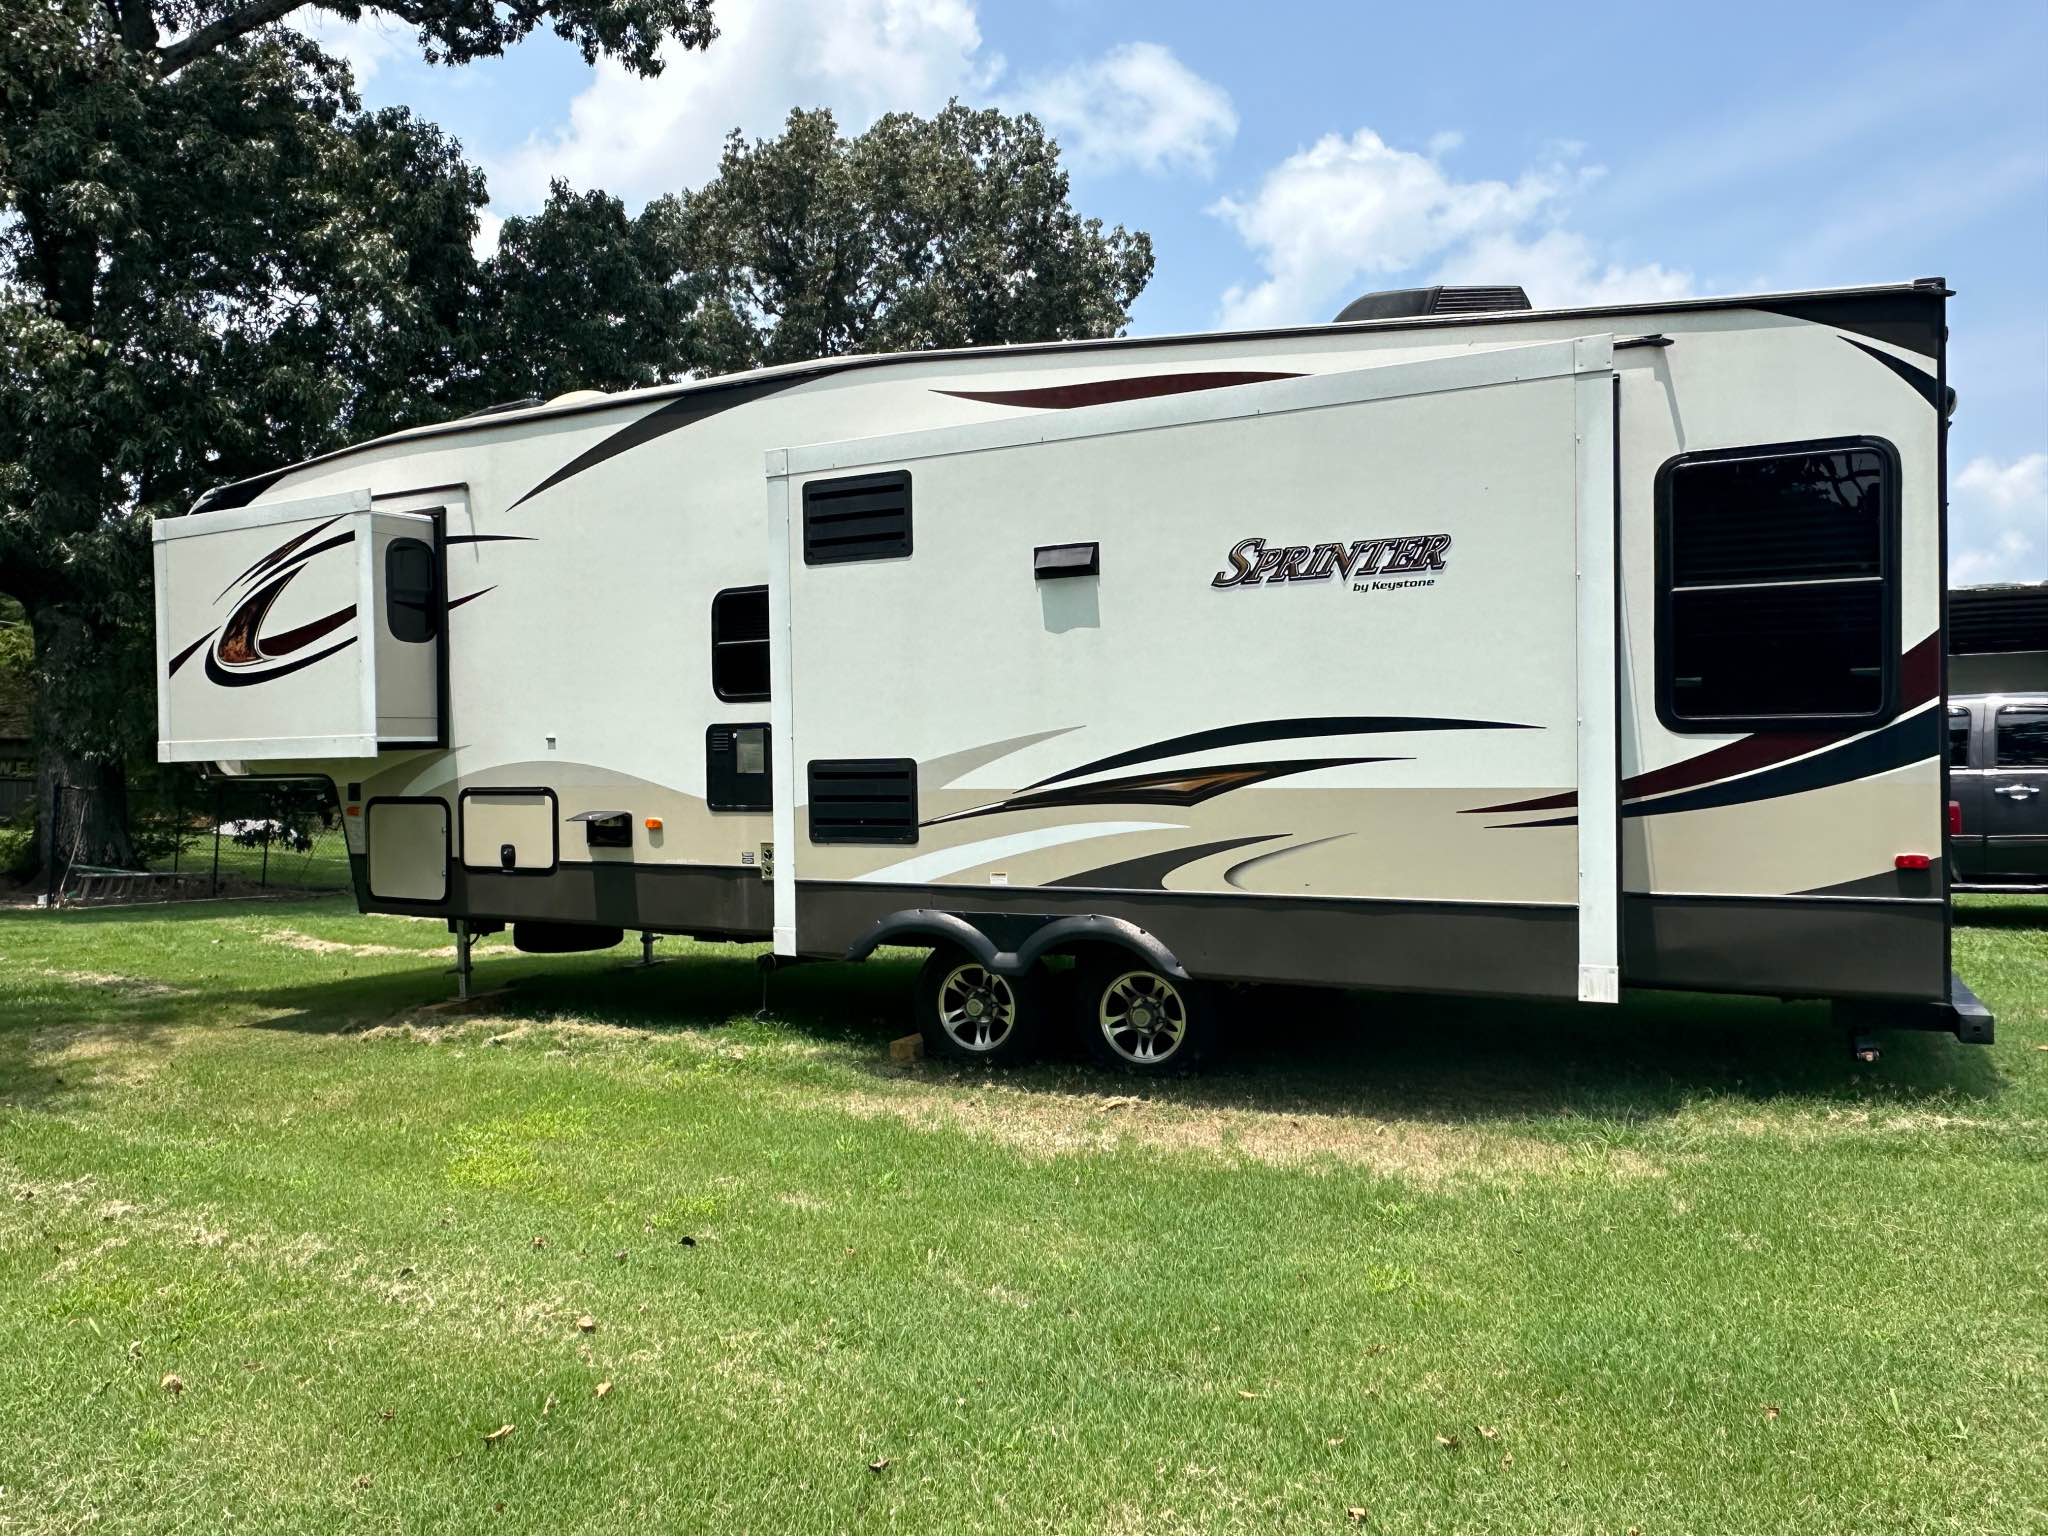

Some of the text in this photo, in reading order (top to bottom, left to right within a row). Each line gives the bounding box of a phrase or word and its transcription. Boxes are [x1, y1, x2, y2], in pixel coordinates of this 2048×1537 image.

[1211, 534, 1452, 588] SPRINTER
[1353, 579, 1435, 593] by Keystone
